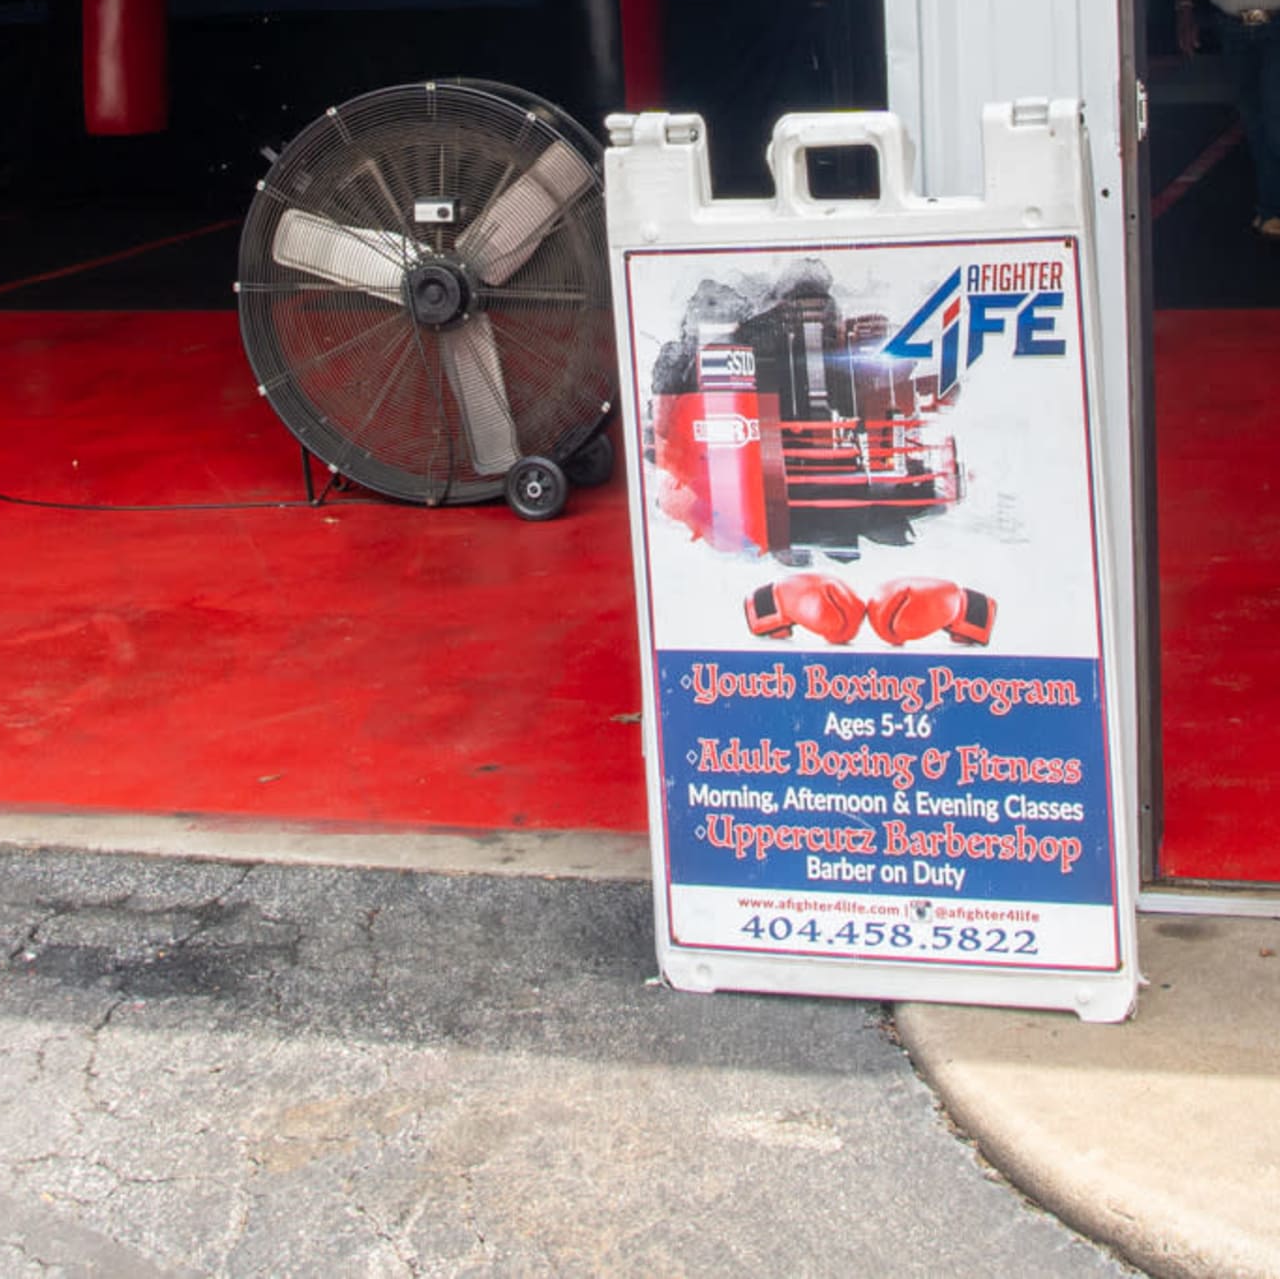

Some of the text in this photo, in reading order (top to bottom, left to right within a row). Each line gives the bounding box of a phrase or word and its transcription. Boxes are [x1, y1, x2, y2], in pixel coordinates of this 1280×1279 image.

[692, 663, 1081, 716] Youth Boxing Program
[824, 712, 932, 740] Ages 5-16
[697, 737, 1082, 790] Adult Boxing & Fitness
[688, 783, 1084, 823] Morning, Afternoon & Evening Classes
[705, 814, 1082, 873] Uppercutz Barbershop
[807, 855, 966, 891] Barber on Duty
[737, 896, 1041, 923] www.afighter4life.com @afighter4life
[741, 915, 1039, 956] 404.458.5822
